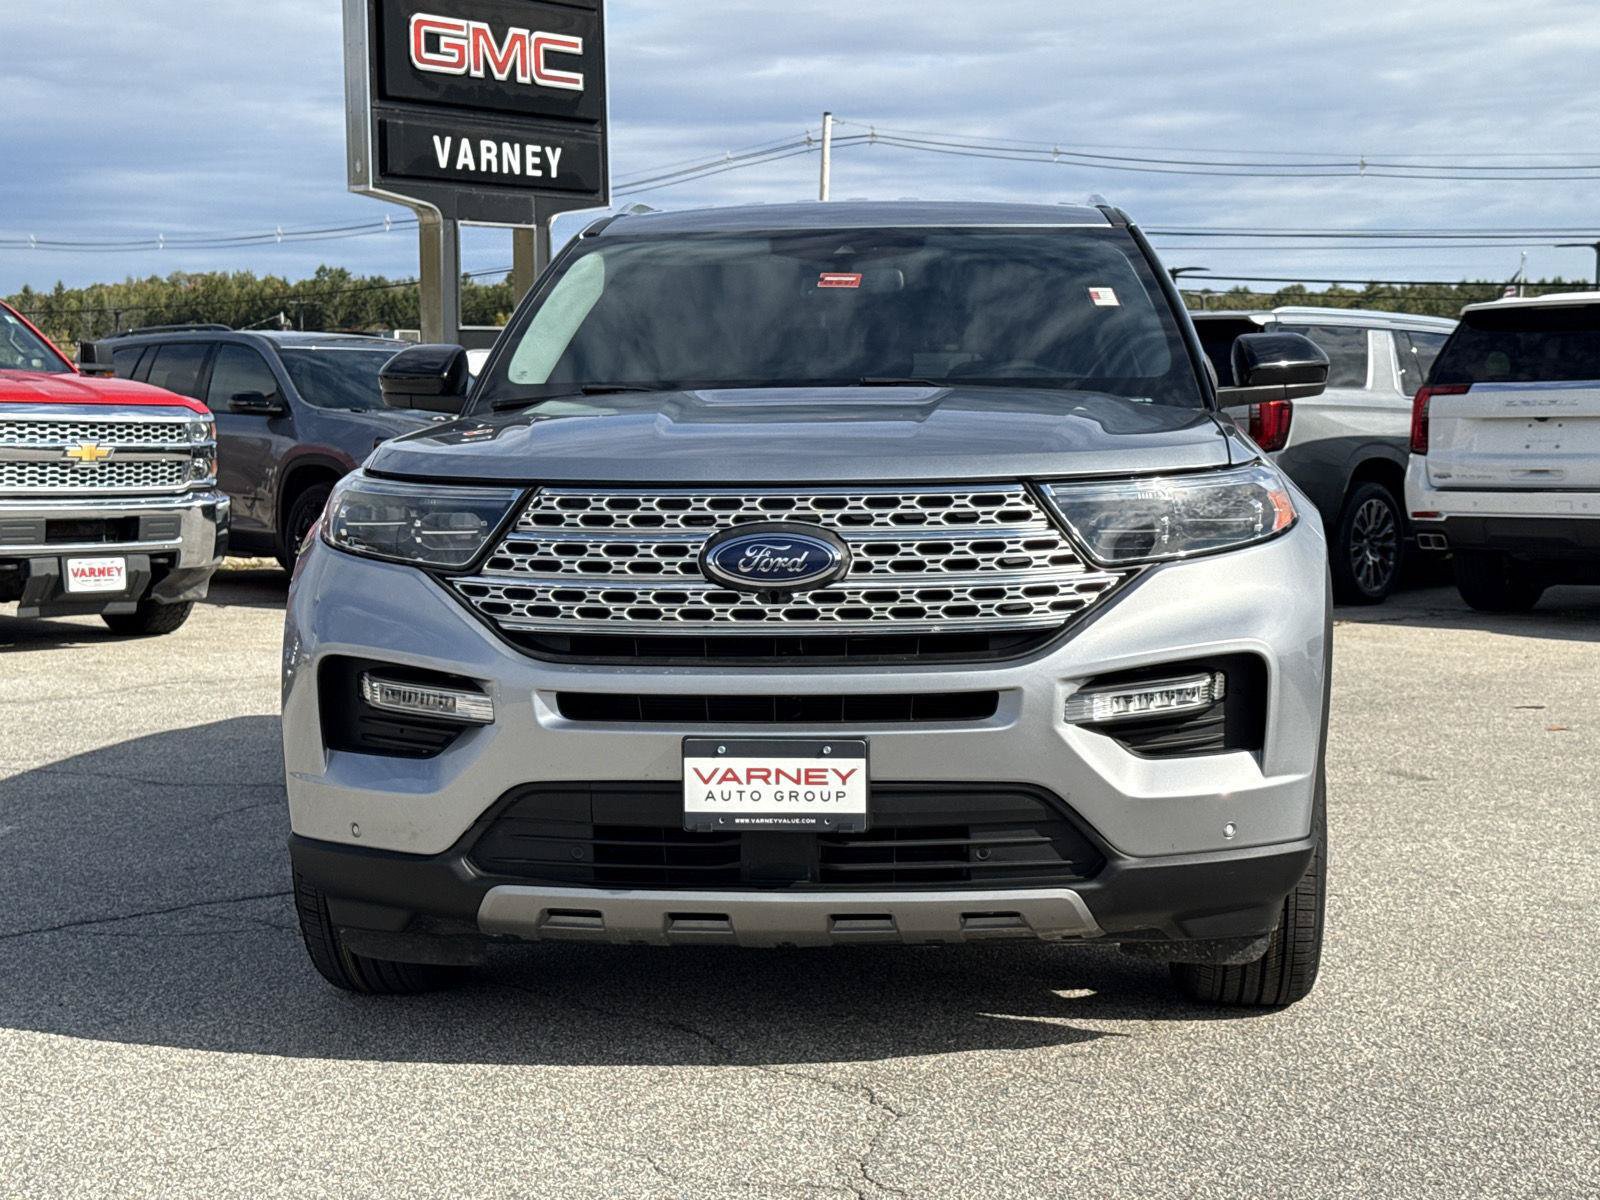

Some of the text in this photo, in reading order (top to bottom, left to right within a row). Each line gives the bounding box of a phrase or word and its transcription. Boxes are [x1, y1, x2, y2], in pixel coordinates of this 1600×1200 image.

[408, 12, 584, 91] GMC
[432, 134, 562, 178] VARNEY
[737, 543, 809, 573] Ford
[71, 566, 123, 577] VARNEY
[692, 767, 858, 785] VARNEY
[705, 790, 847, 802] AUTO GROUP
